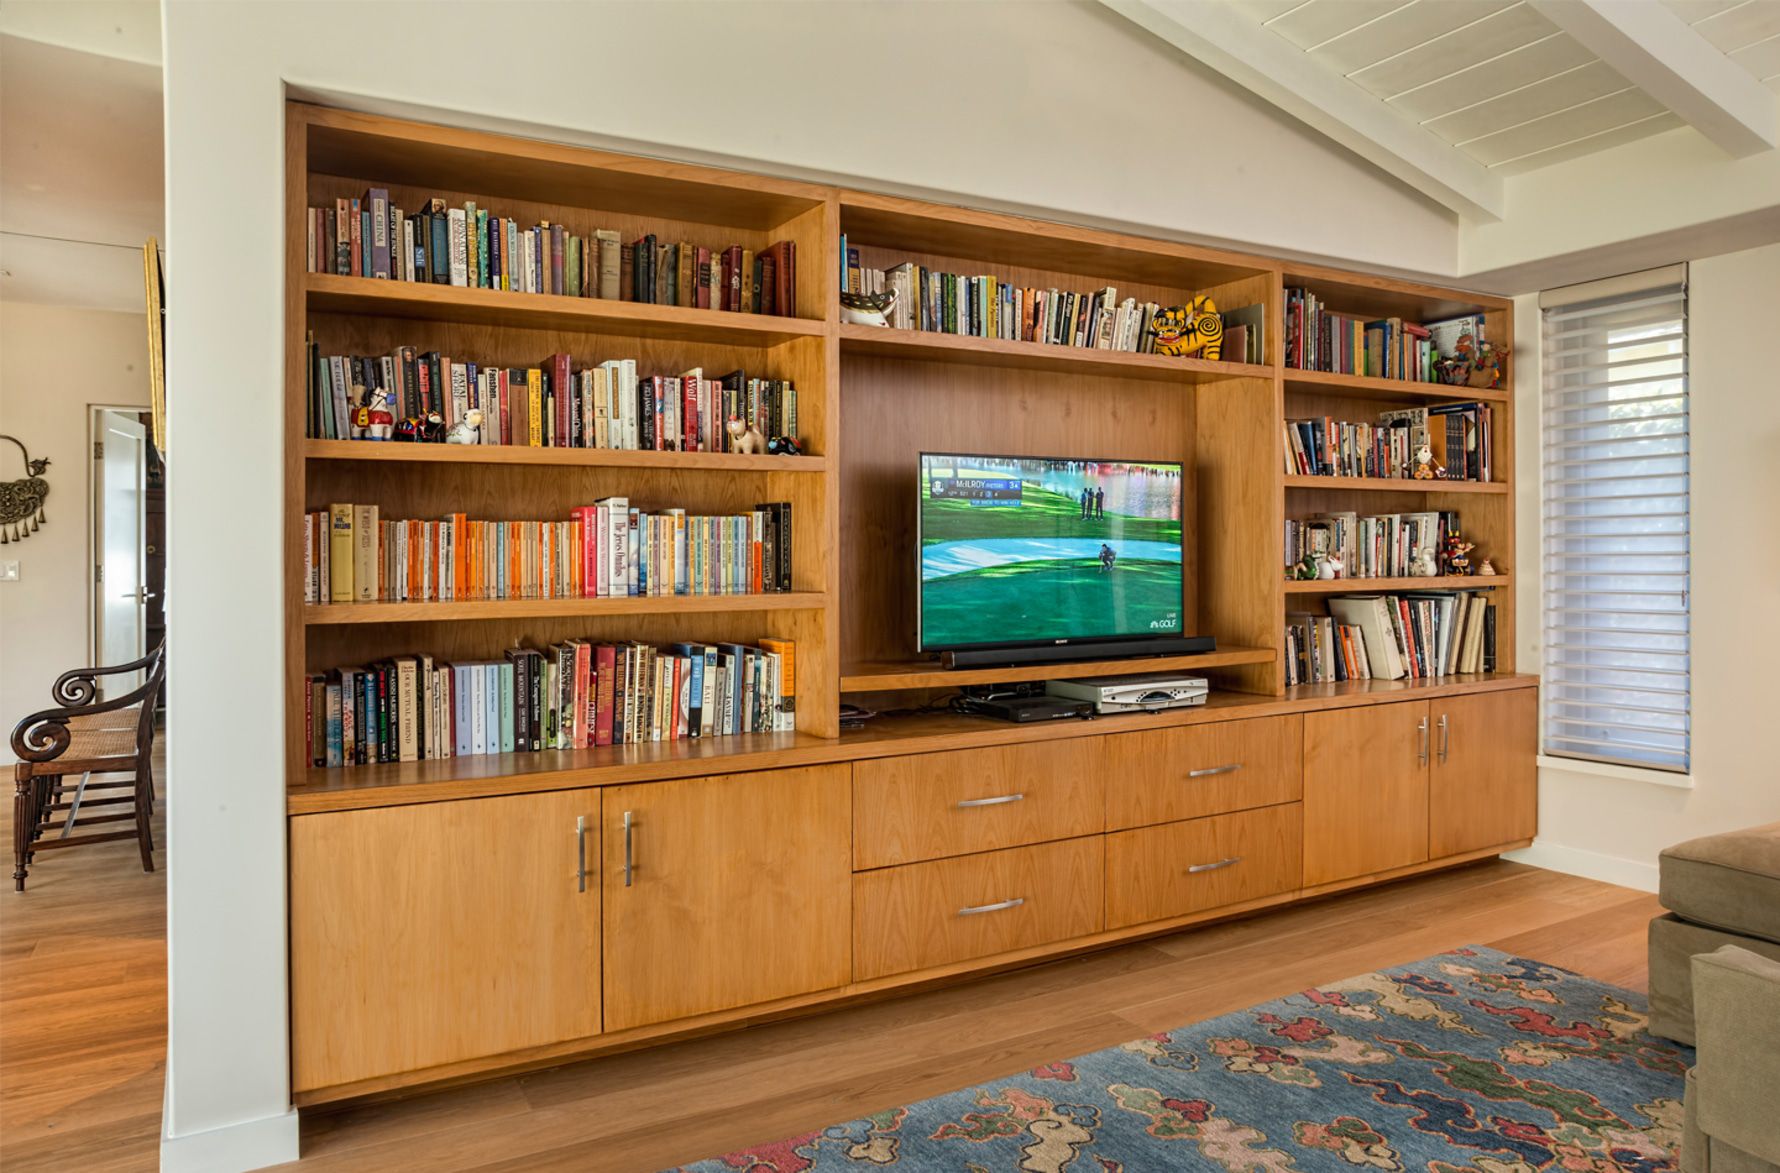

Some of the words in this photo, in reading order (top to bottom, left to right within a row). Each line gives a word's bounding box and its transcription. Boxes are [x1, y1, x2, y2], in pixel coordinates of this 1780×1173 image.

[375, 213, 385, 243] CHINA
[415, 248, 425, 265] Salt
[488, 368, 498, 399] Fanshen
[688, 379, 697, 401] Wolf
[643, 398, 653, 416] JAMES
[614, 522, 626, 532] The
[613, 533, 626, 551] Jeeves
[614, 552, 626, 578] Omnibus
[1159, 619, 1177, 628] GOLF
[518, 659, 526, 673] SOUL
[404, 673, 412, 688] OUR
[518, 675, 526, 704] MOUNTAIN
[404, 689, 412, 717] MUTUAL
[404, 718, 412, 744] FRIEND
